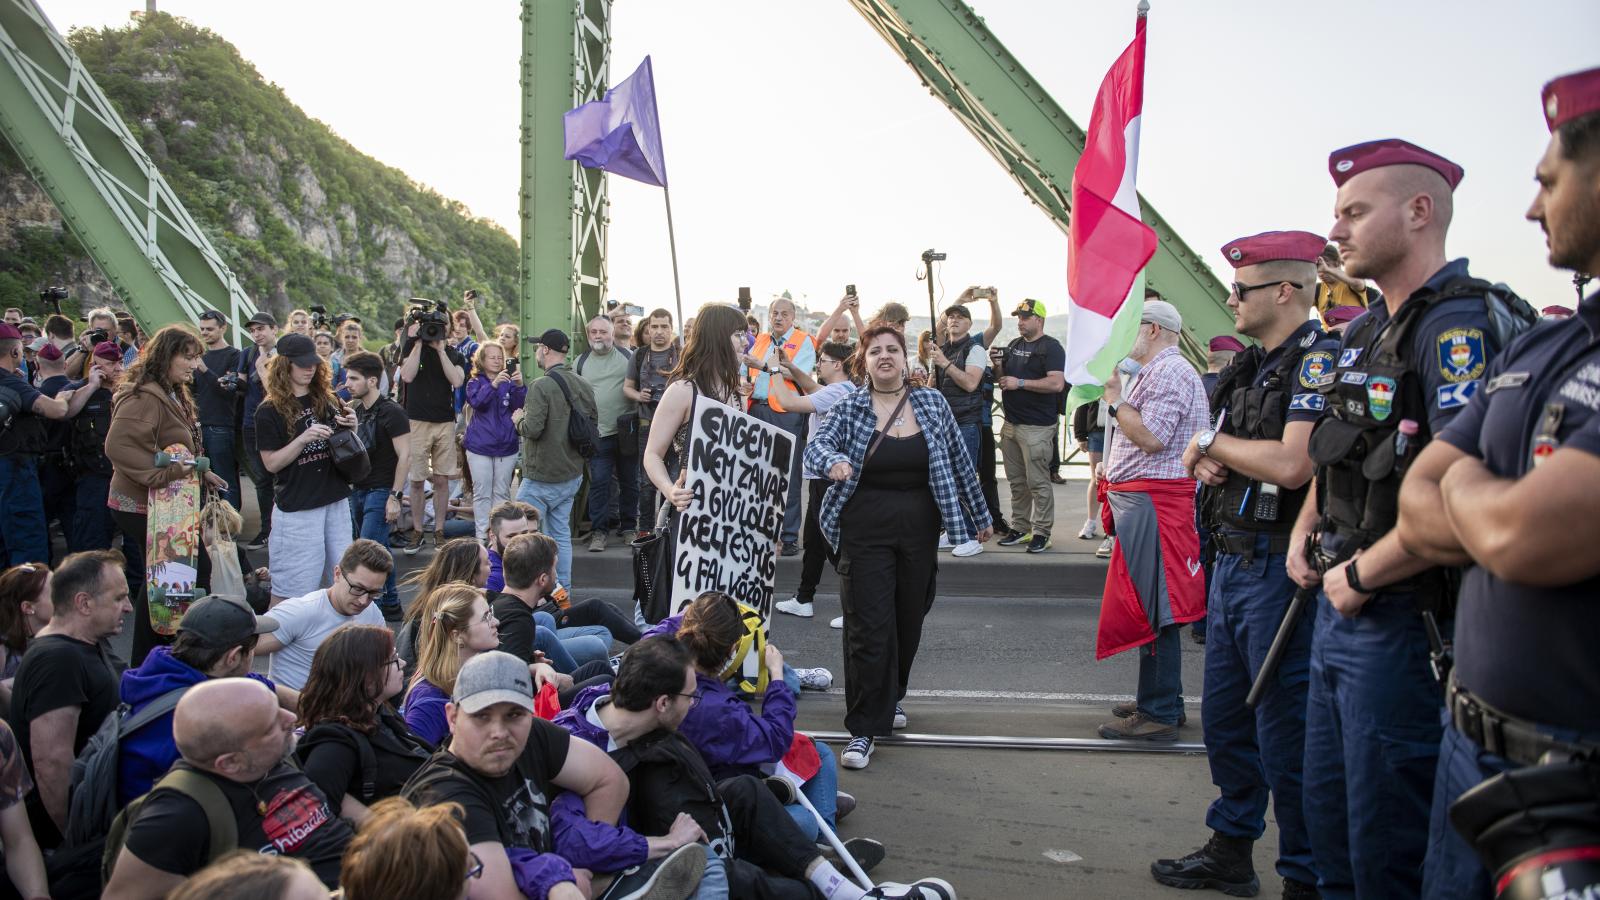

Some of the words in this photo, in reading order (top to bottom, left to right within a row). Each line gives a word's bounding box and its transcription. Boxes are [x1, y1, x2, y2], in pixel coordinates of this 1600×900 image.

[701, 407, 773, 463] ENGEM
[688, 479, 705, 511] A
[692, 437, 737, 487] NEM
[737, 459, 789, 512] ZAVAR
[677, 550, 693, 589] 4
[694, 555, 727, 593] FAL
